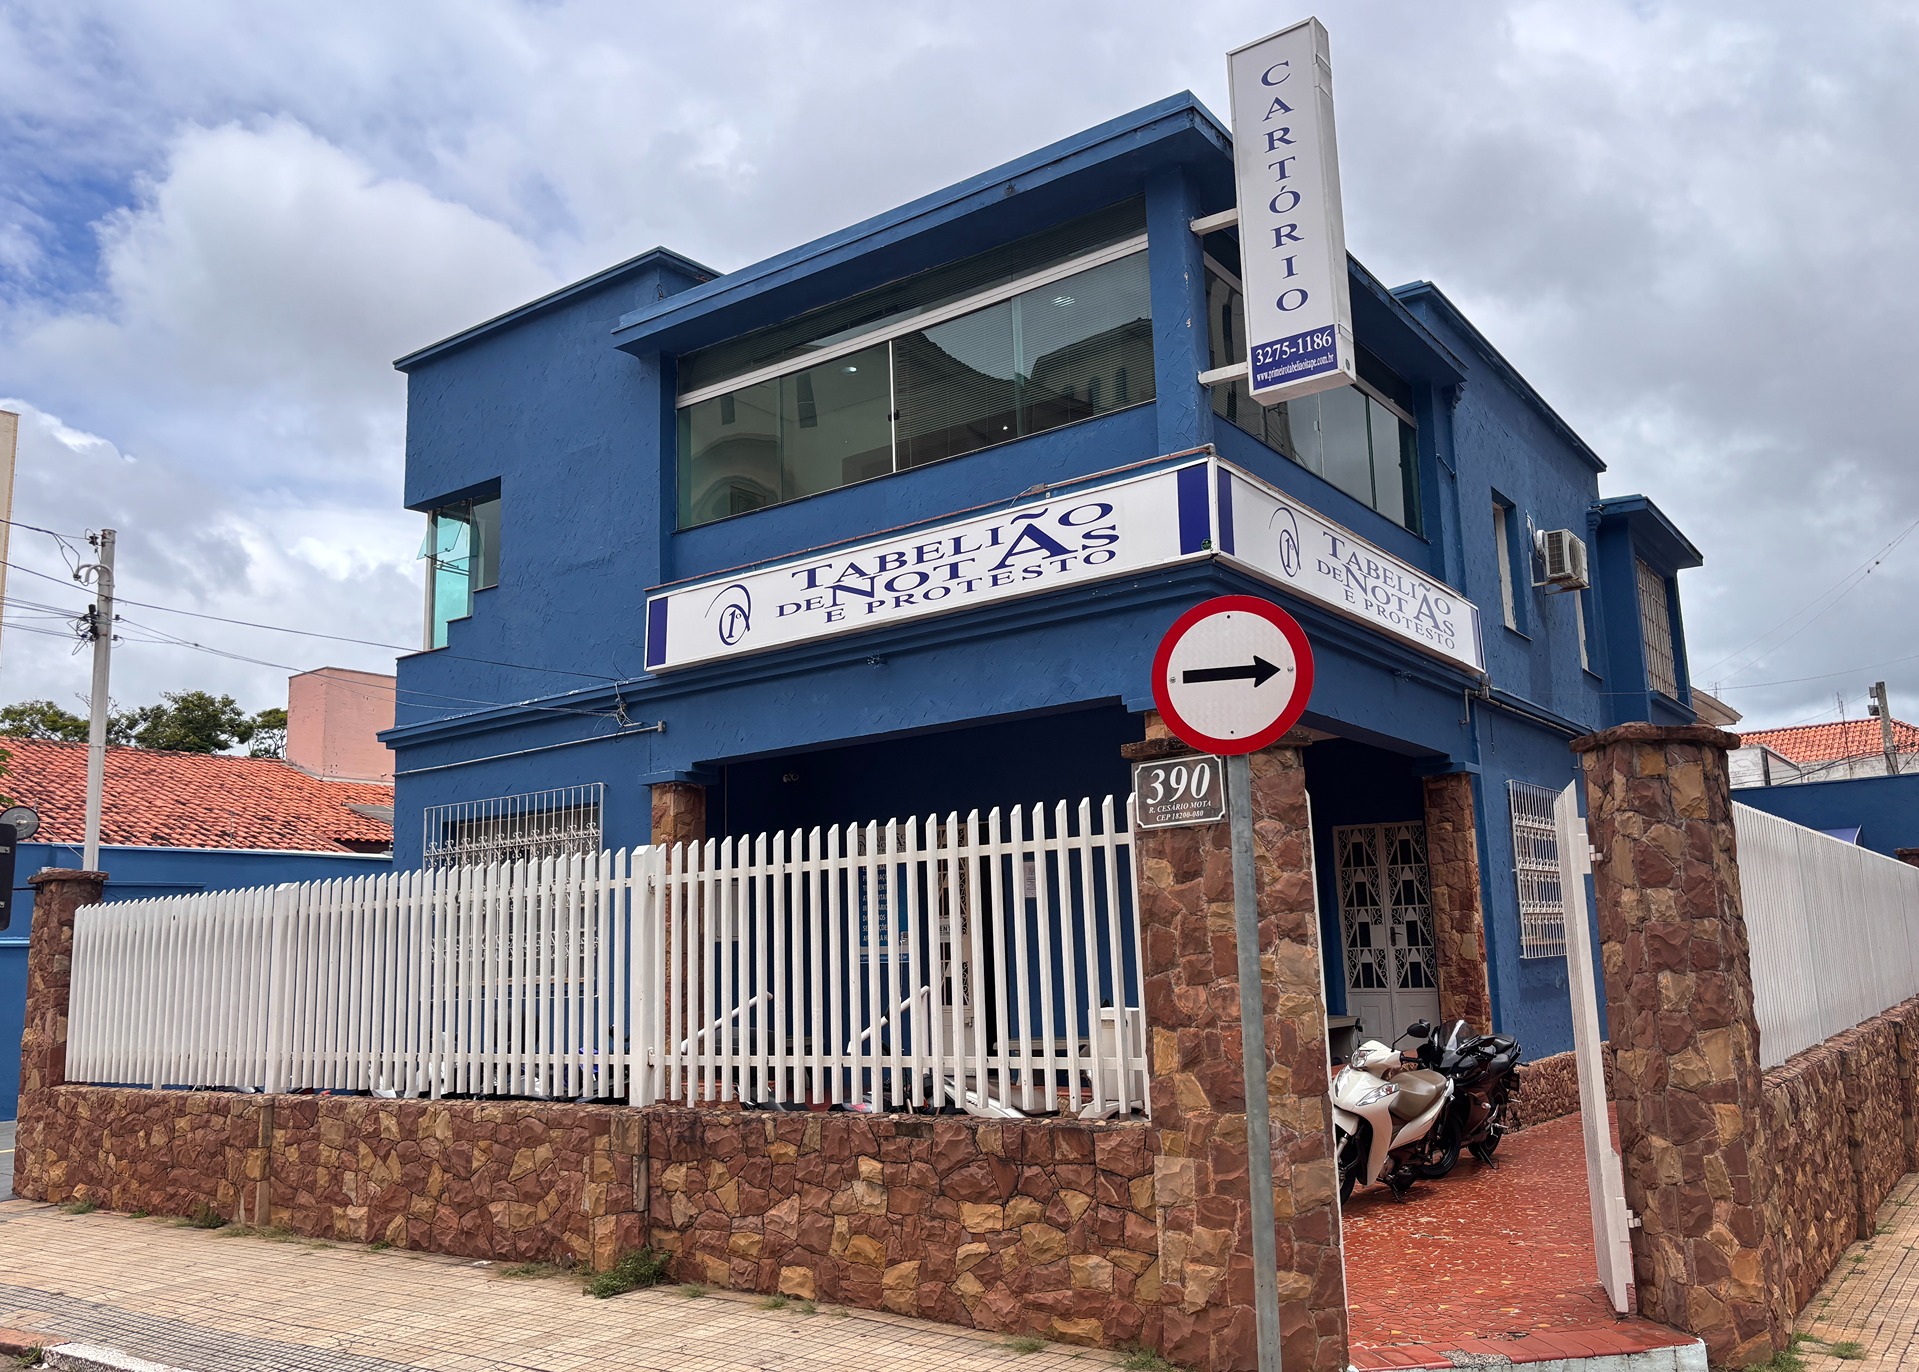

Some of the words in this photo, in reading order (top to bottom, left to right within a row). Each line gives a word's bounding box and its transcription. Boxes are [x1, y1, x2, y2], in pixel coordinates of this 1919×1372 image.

[1260, 60, 1309, 312] CARTÓRIO
[1255, 329, 1332, 366] 3275-1186
[776, 596, 825, 618] DE
[824, 522, 1120, 610] NOTAS
[791, 503, 1114, 591] TABELIÃO
[1323, 531, 1452, 616] TABELIÃO
[825, 608, 846, 623] E
[866, 549, 1117, 615] PROTESTO
[1316, 558, 1344, 583] DE
[1342, 563, 1456, 638] NOTAS
[1344, 589, 1355, 604] E
[1364, 598, 1455, 650] PROTESTO
[1146, 763, 1211, 804] 390
[1149, 806, 1156, 814] R.
[1157, 802, 1189, 813] CESÁRIO
[1189, 800, 1211, 809] MOTA
[1156, 813, 1171, 822] CEP
